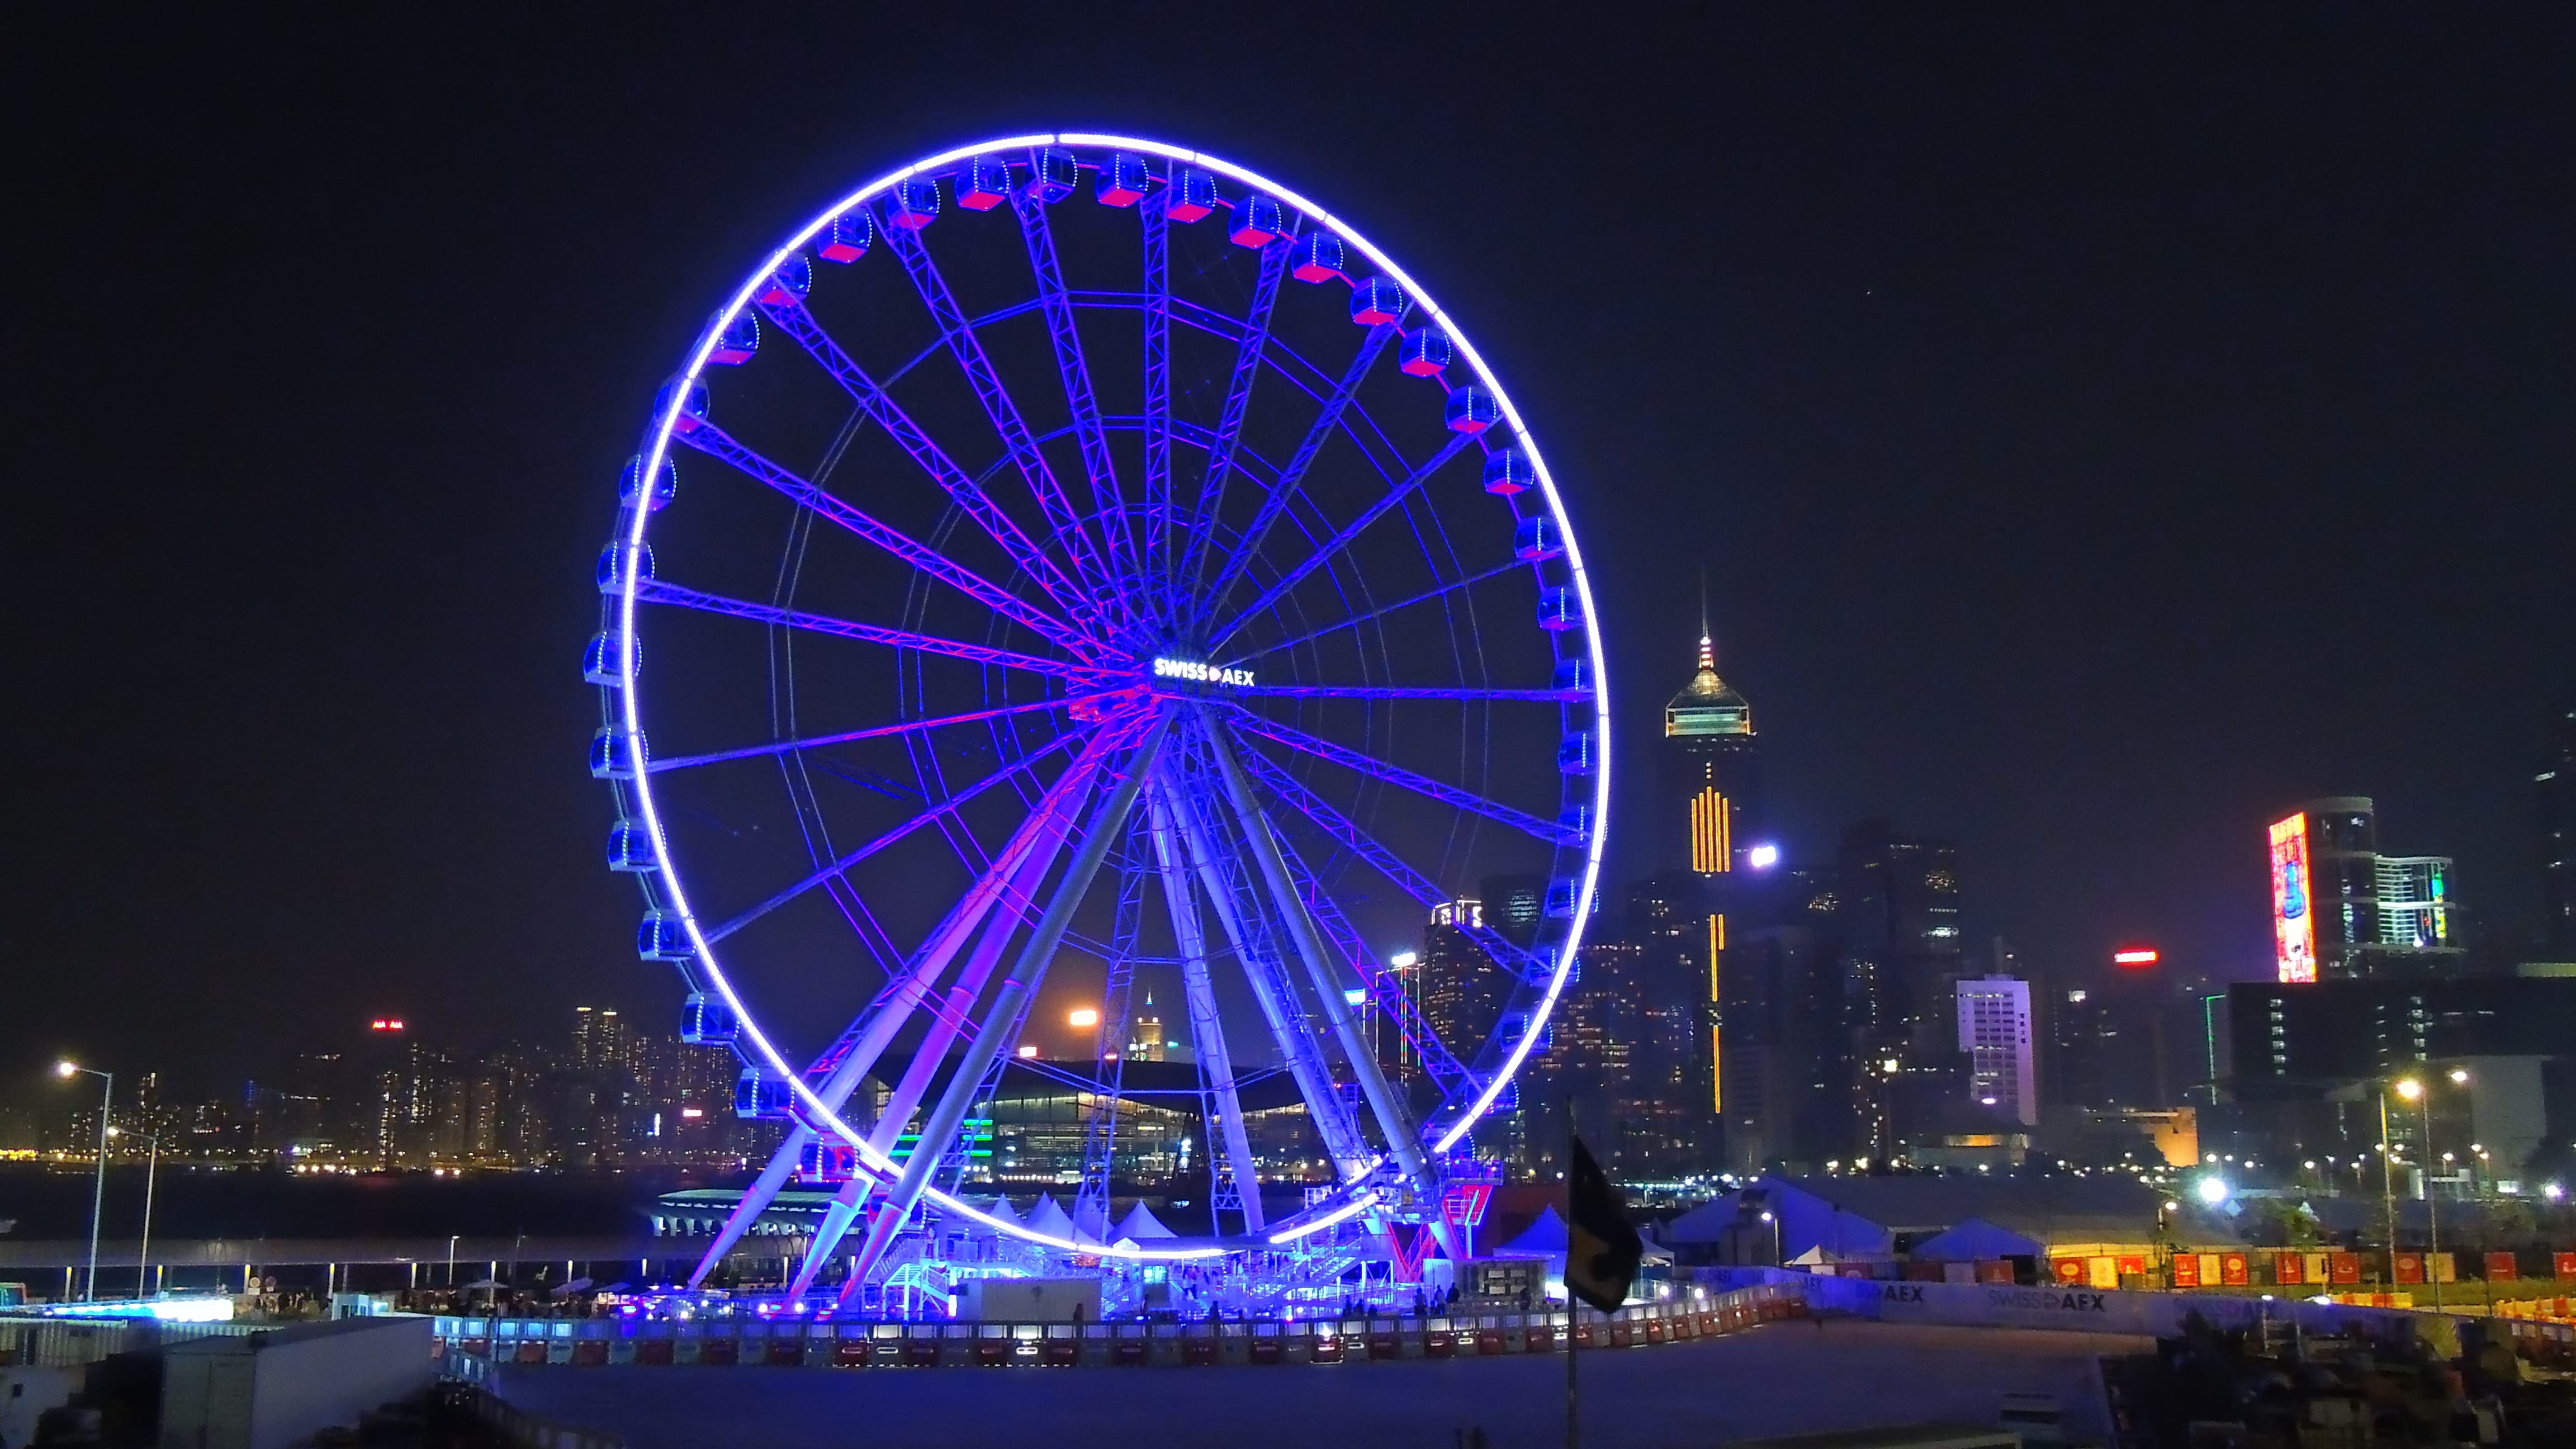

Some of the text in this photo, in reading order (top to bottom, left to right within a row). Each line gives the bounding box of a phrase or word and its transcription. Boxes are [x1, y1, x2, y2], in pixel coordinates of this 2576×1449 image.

[1154, 658, 1254, 686] SWISS AEX
[372, 1020, 403, 1029] AIA AIA
[1883, 1284, 1924, 1303] AEX
[1988, 1290, 2106, 1313] SWISS AEX
